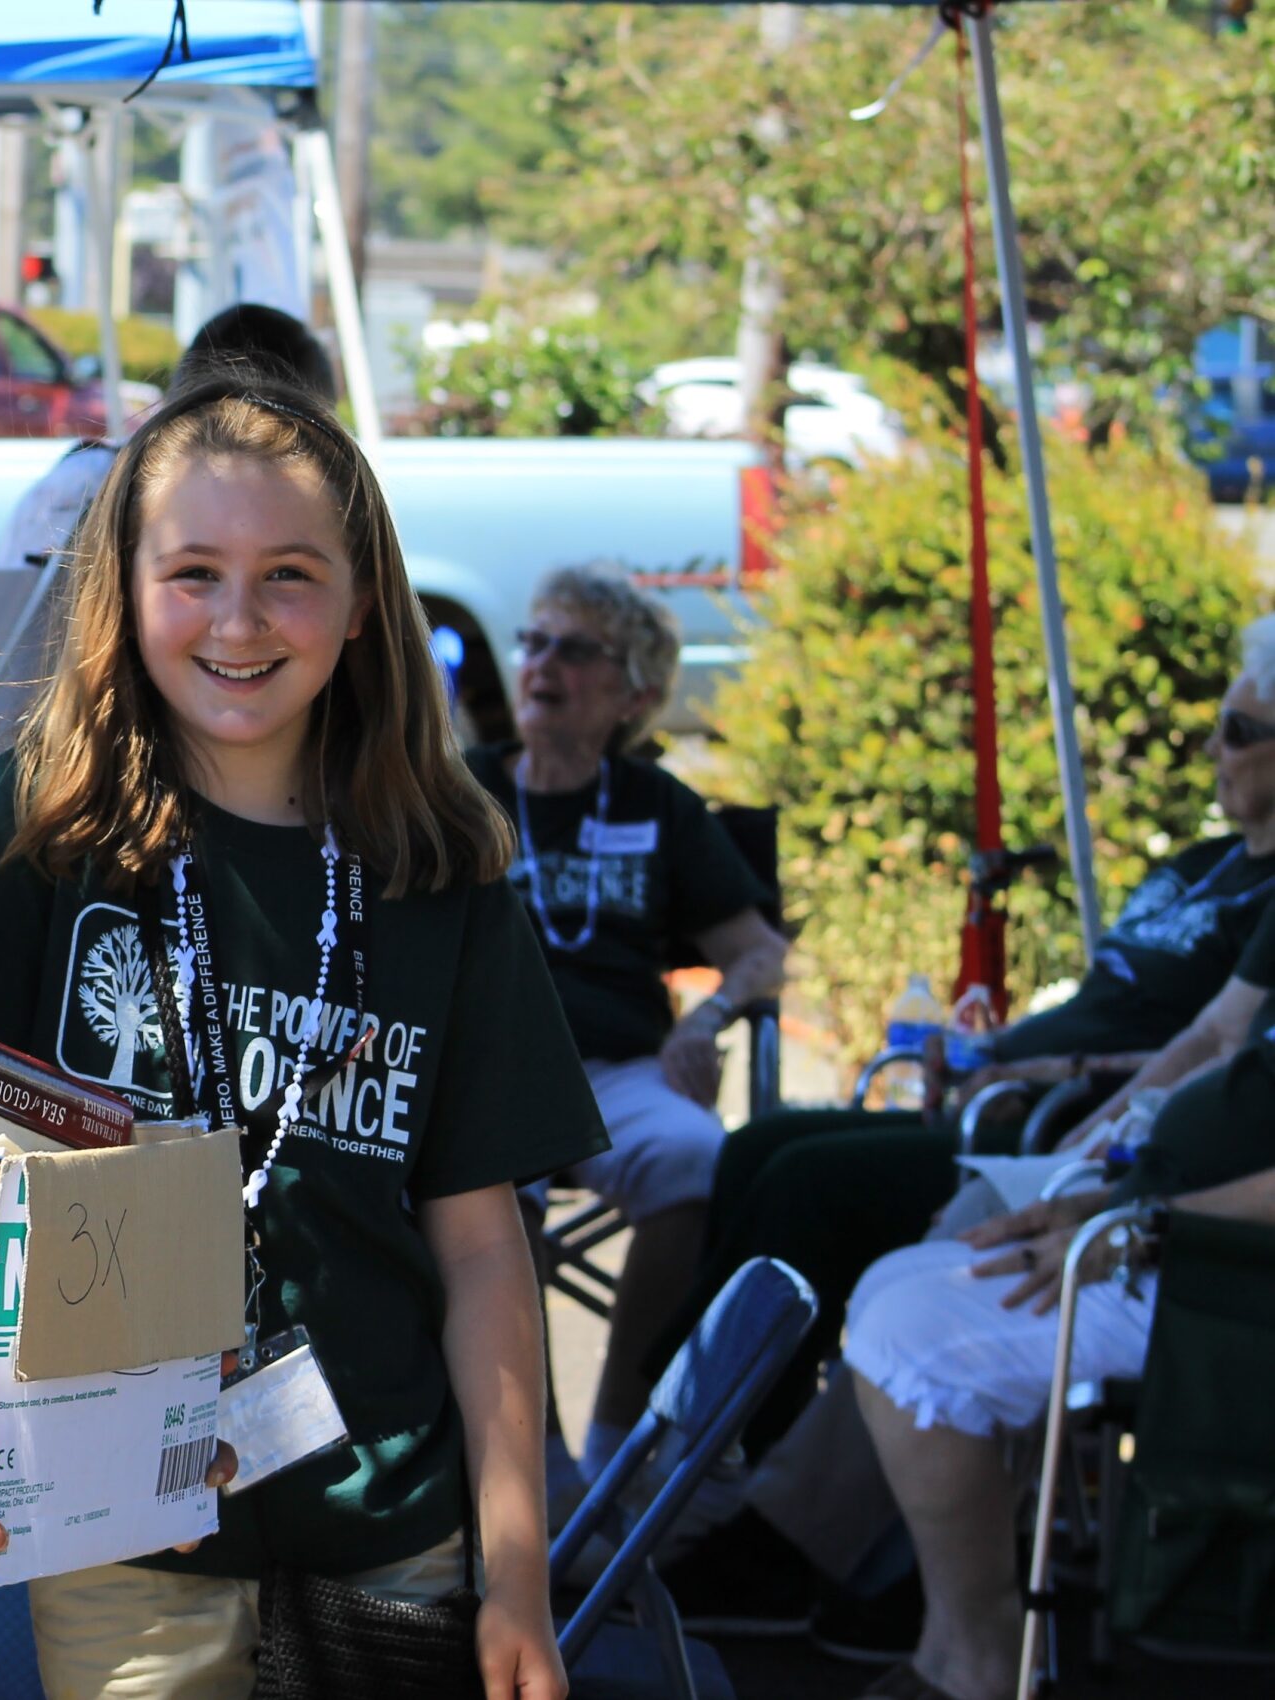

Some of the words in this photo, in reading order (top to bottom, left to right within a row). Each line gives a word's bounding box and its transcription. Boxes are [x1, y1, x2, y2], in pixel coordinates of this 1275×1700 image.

[348, 853, 364, 923] RENCE
[187, 893, 218, 1006] DIFFERENCE
[206, 1008, 220, 1021] A
[207, 1023, 228, 1074] MAKE
[384, 1022, 427, 1071] OF
[30, 1095, 40, 1111] of
[40, 1098, 67, 1126] SEA
[83, 1097, 125, 1127] PHILBRICK
[147, 1101, 173, 1119] DAY,
[331, 1137, 406, 1163] TOGETHER
[164, 1403, 186, 1430] 8644S
